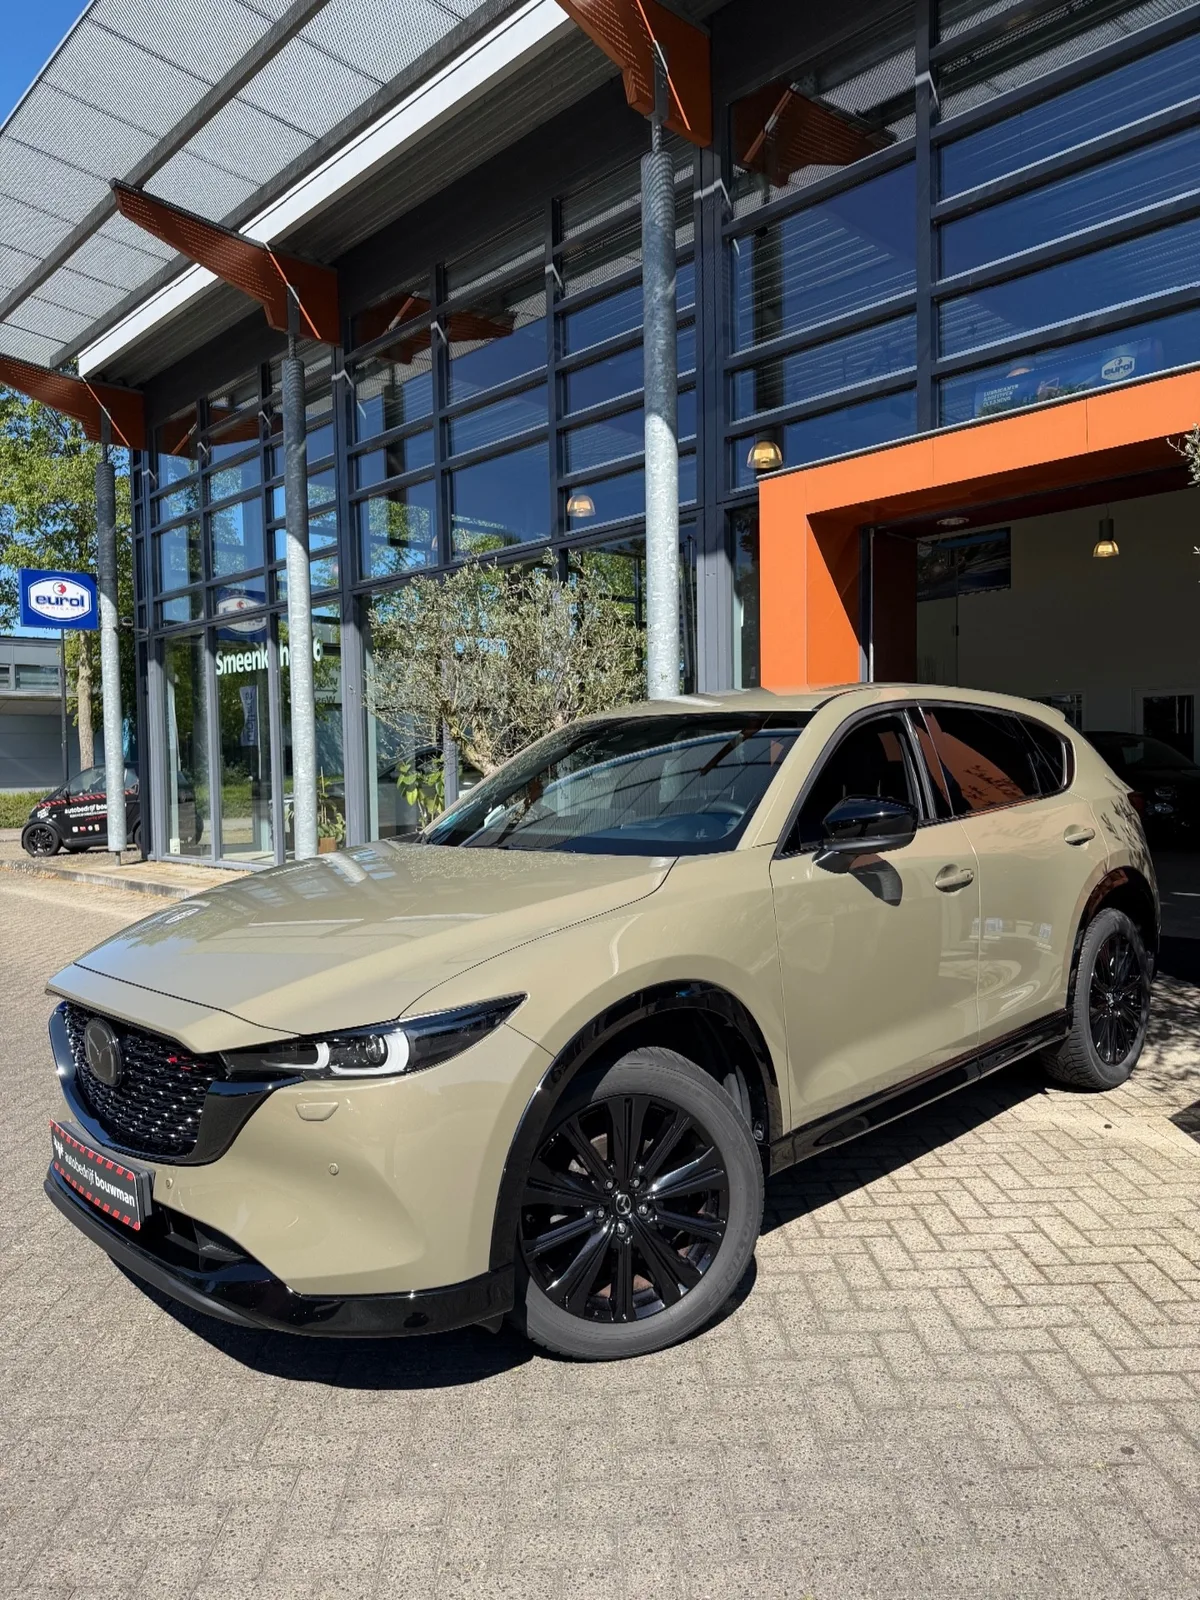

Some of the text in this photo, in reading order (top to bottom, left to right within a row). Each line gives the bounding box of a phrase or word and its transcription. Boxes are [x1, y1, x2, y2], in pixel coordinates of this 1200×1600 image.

[1104, 361, 1133, 375] eurol
[35, 595, 85, 607] eurol
[312, 638, 323, 661] 6
[64, 1152, 136, 1208] autobedrijf bouwman
